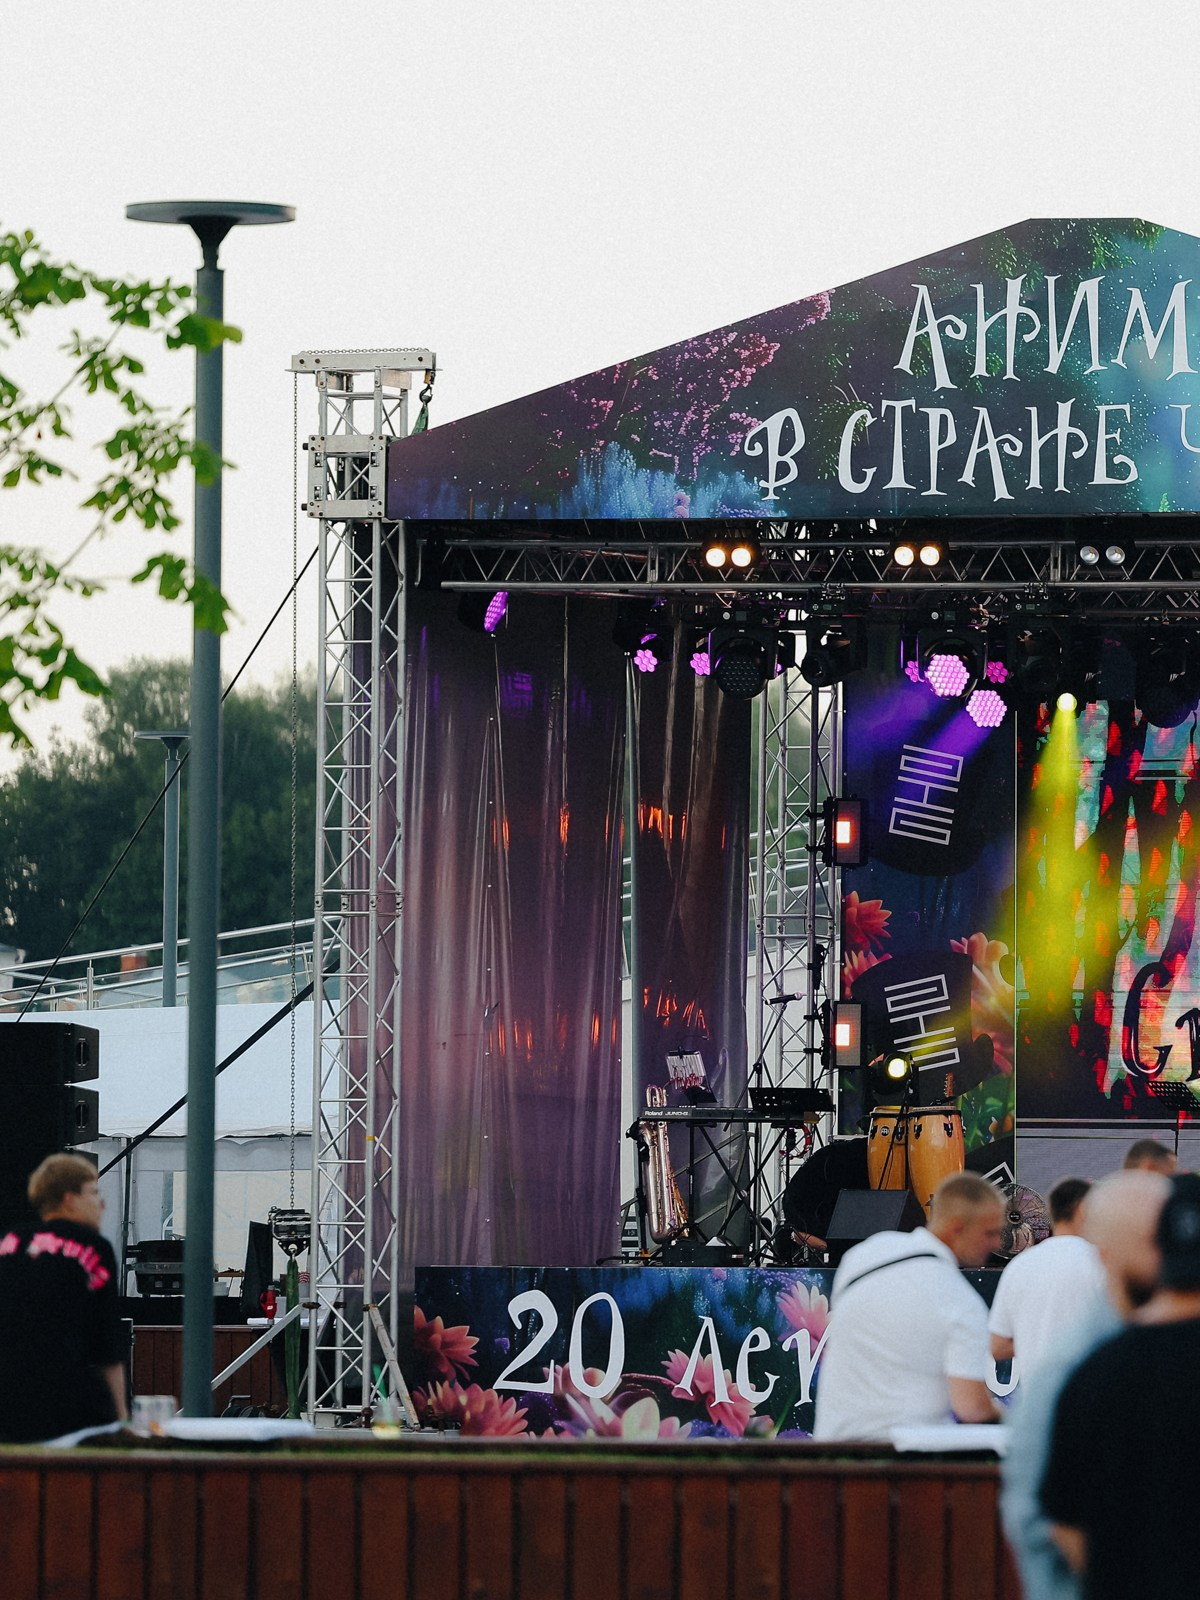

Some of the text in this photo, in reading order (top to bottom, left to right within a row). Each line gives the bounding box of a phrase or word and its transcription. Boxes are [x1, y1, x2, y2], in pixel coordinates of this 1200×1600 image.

[744, 406, 805, 500] В
[837, 398, 1139, 502] СТРАНЕ
[493, 1288, 626, 1399] 20
